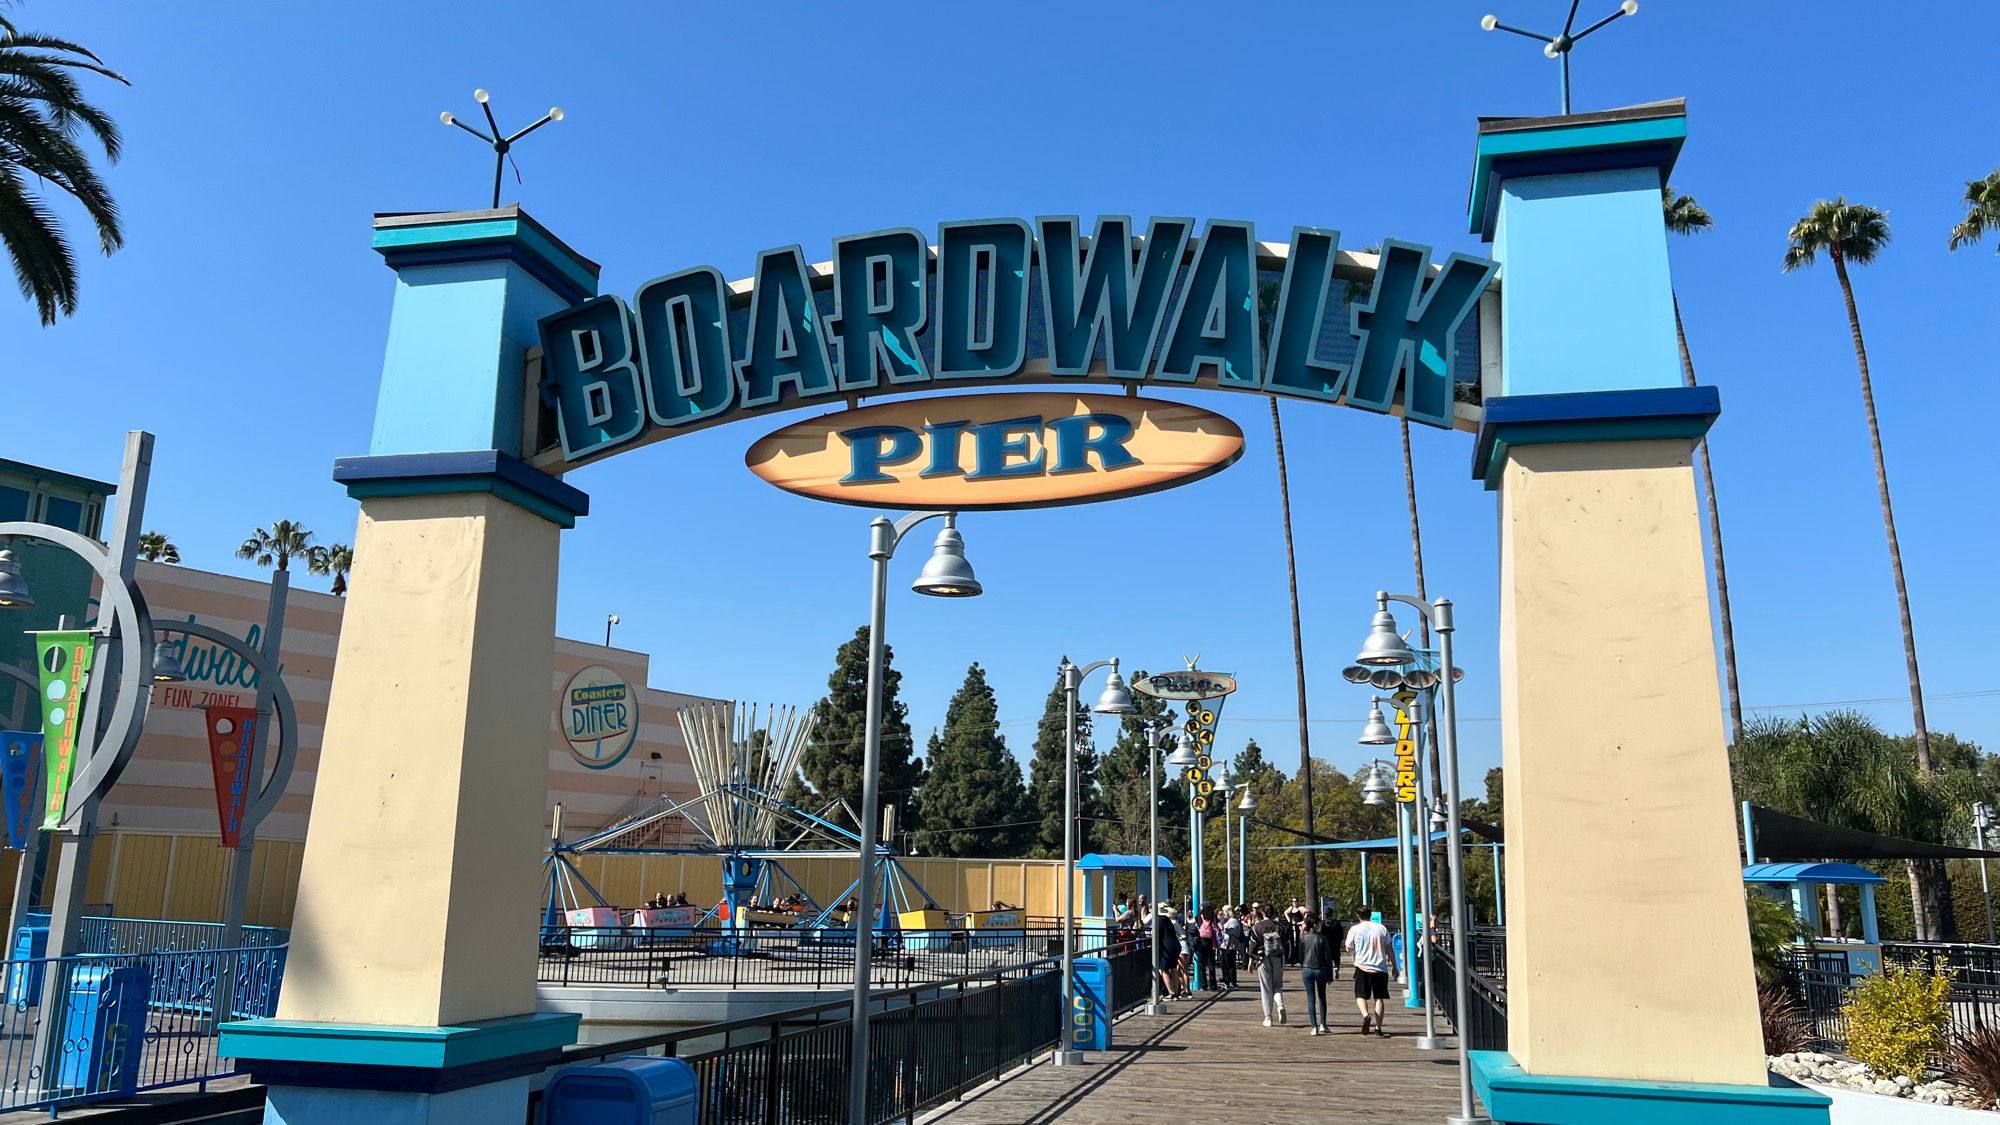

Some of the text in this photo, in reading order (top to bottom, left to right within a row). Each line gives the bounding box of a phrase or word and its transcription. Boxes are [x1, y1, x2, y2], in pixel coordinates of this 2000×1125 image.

[537, 215, 1501, 461] BOARDWALK
[838, 413, 1144, 486] PIER
[164, 687, 193, 708] FUN
[574, 687, 625, 702] Coasters
[1149, 675, 1227, 699] Pacific
[50, 646, 84, 811] BOARDWALK
[572, 702, 627, 735] DINER
